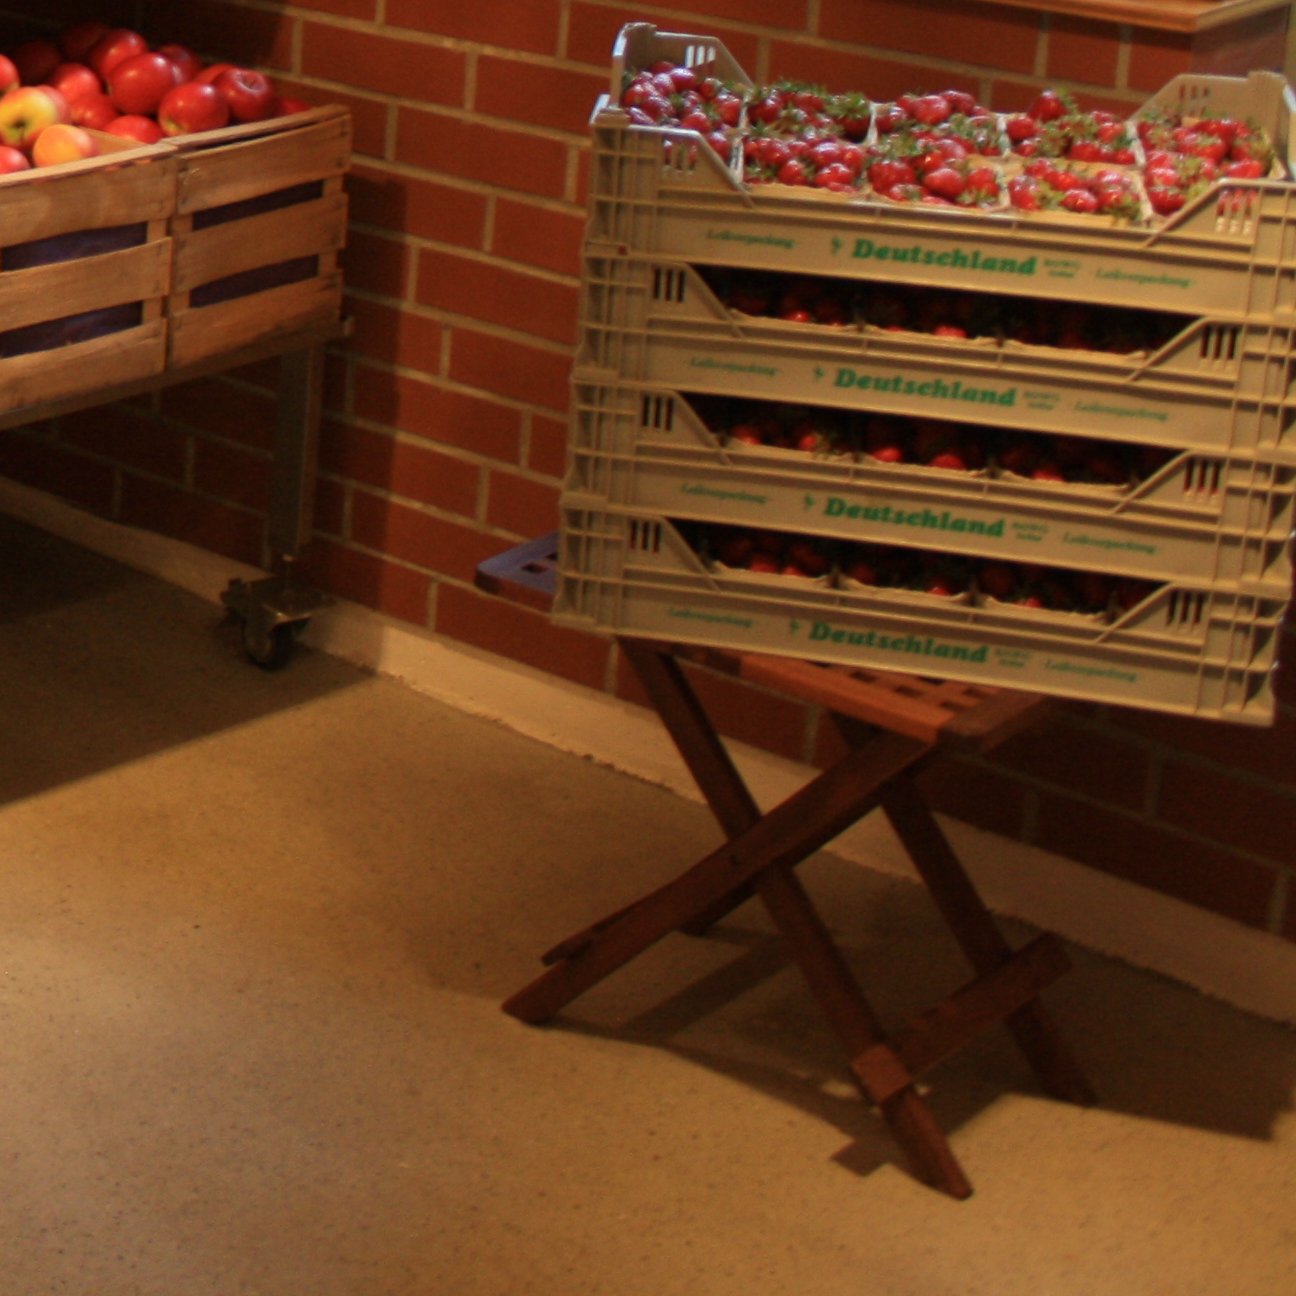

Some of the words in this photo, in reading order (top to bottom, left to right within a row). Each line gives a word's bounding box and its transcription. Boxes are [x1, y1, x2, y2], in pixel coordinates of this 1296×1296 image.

[852, 237, 1038, 277] Deutschland
[834, 367, 1016, 408] Deutschland
[823, 497, 1005, 538] Deutschland
[809, 620, 989, 664] Deutschland
